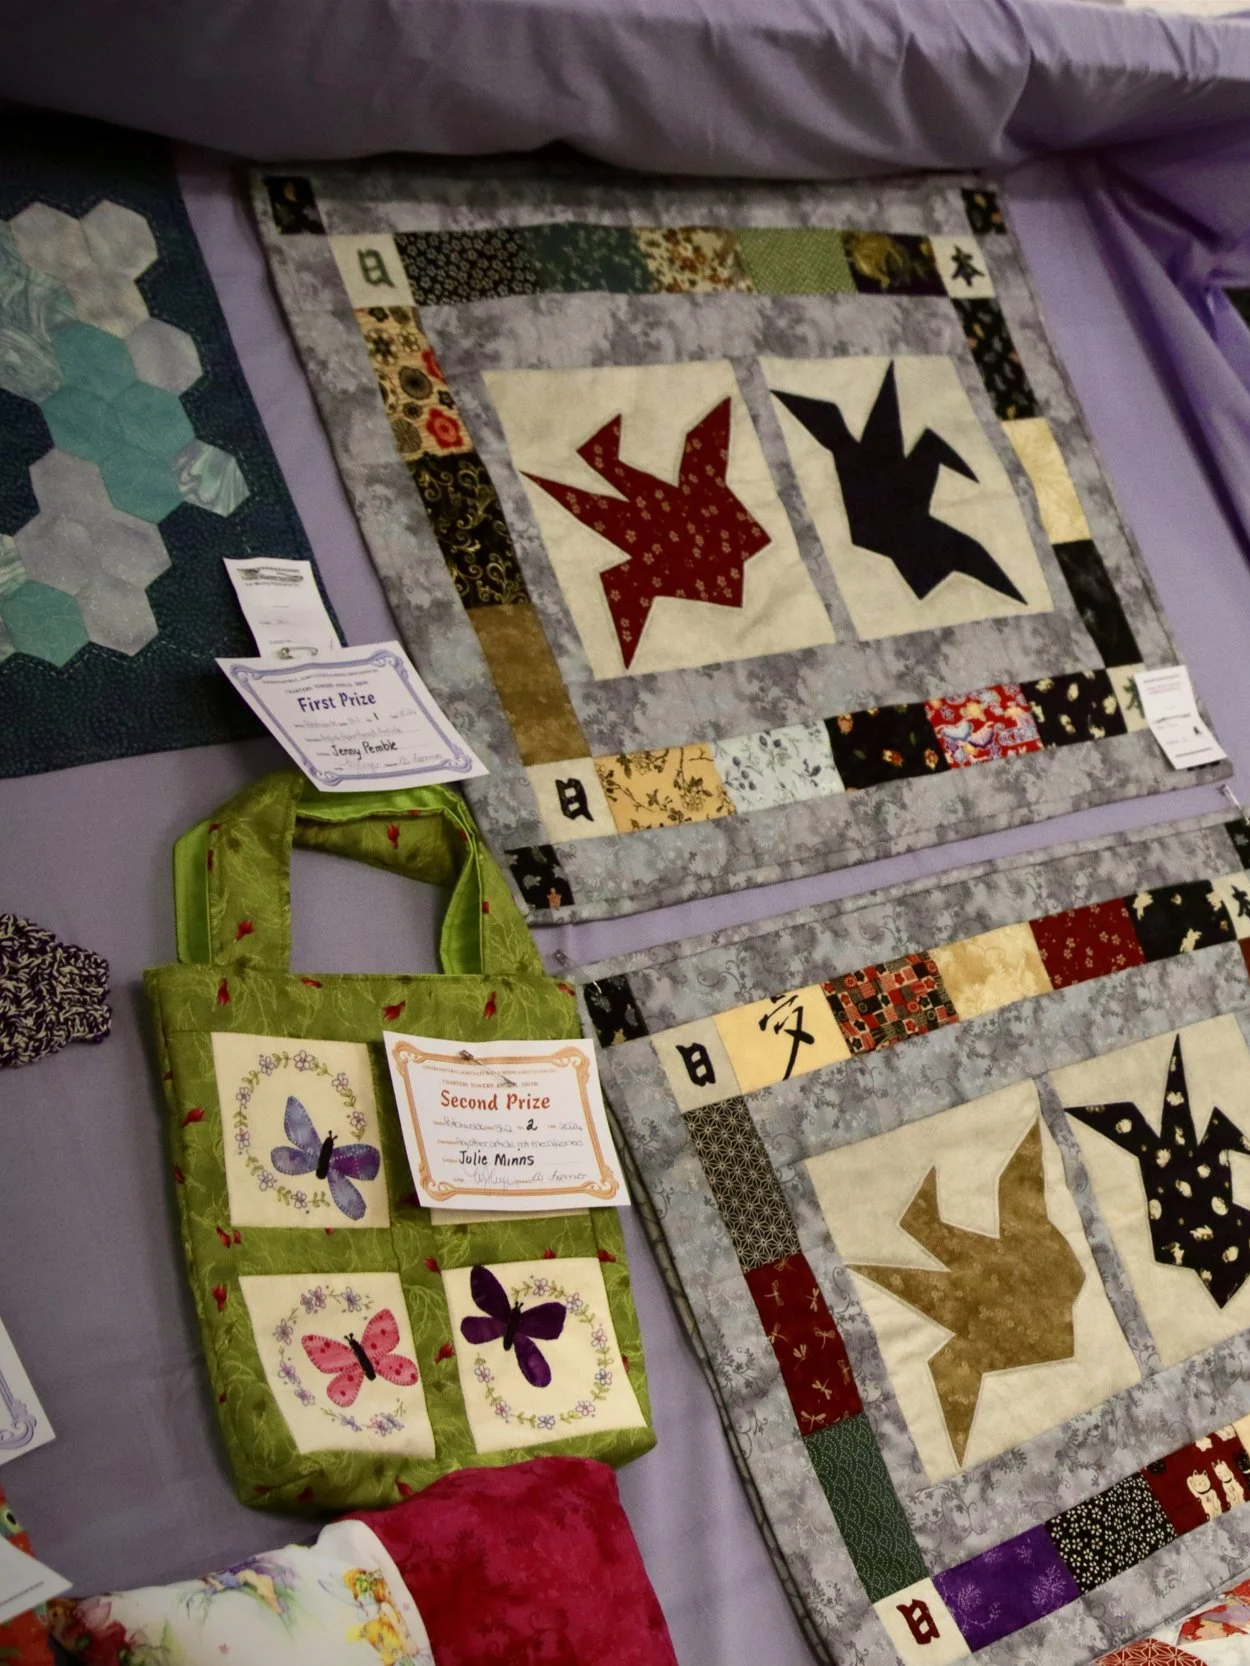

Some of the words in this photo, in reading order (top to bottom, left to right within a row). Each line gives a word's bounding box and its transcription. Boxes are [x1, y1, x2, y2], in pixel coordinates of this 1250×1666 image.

[297, 697, 336, 713] First
[338, 691, 377, 708] Prize
[331, 744, 363, 760] Jenny
[440, 1089, 498, 1111] Second
[506, 1092, 551, 1110] Prize
[526, 1118, 539, 1131] 2
[458, 1149, 488, 1166] Julie
[494, 1148, 535, 1166] Minns
